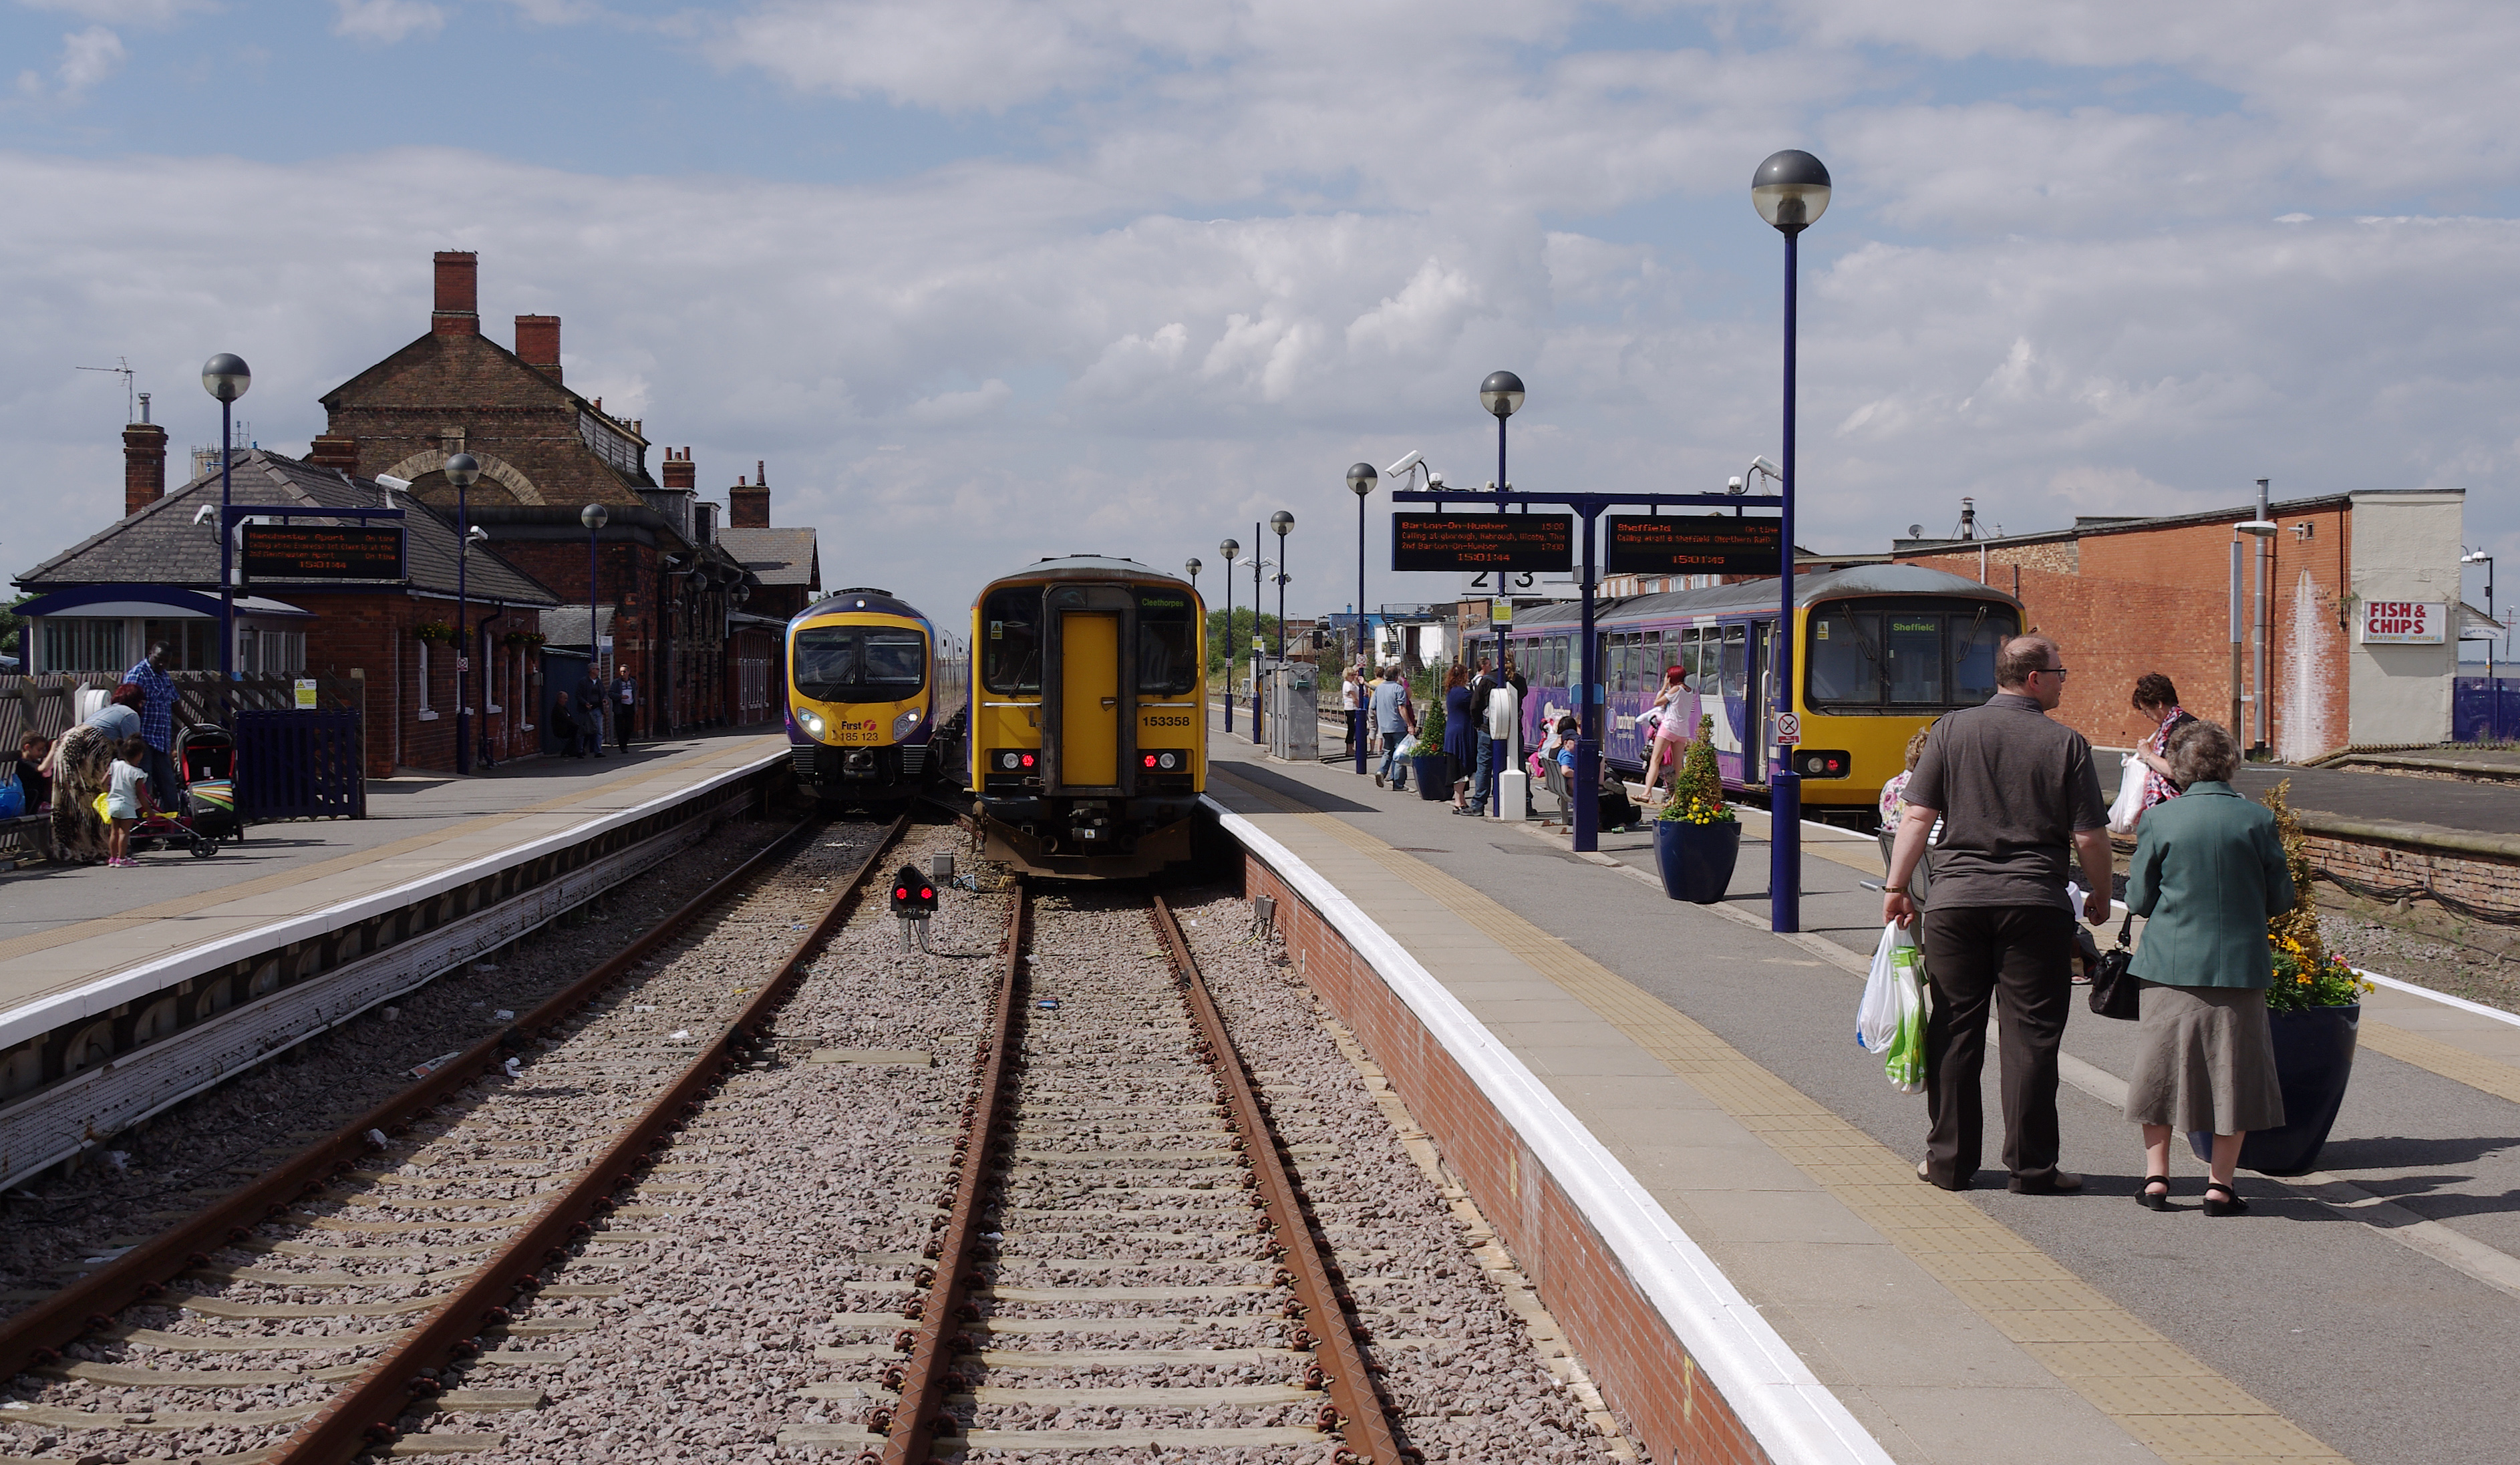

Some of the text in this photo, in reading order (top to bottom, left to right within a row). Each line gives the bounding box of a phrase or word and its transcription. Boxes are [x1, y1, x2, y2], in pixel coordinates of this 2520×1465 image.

[1617, 523, 1672, 532] Sheffield
[1402, 532, 1426, 541] Calling
[1458, 552, 1511, 562] 15:01:44
[1672, 554, 1725, 564] 15:01:45
[1471, 571, 1488, 587] 2
[1515, 571, 1534, 588] 3
[1142, 598, 1184, 607] Cleethorpes
[2370, 603, 2426, 618] FISH &
[1893, 623, 1935, 631] Sheffield
[2368, 619, 2424, 634] CHIPS
[842, 721, 861, 729] First
[1143, 717, 1190, 726] 153358
[841, 733, 879, 741] 185 123
